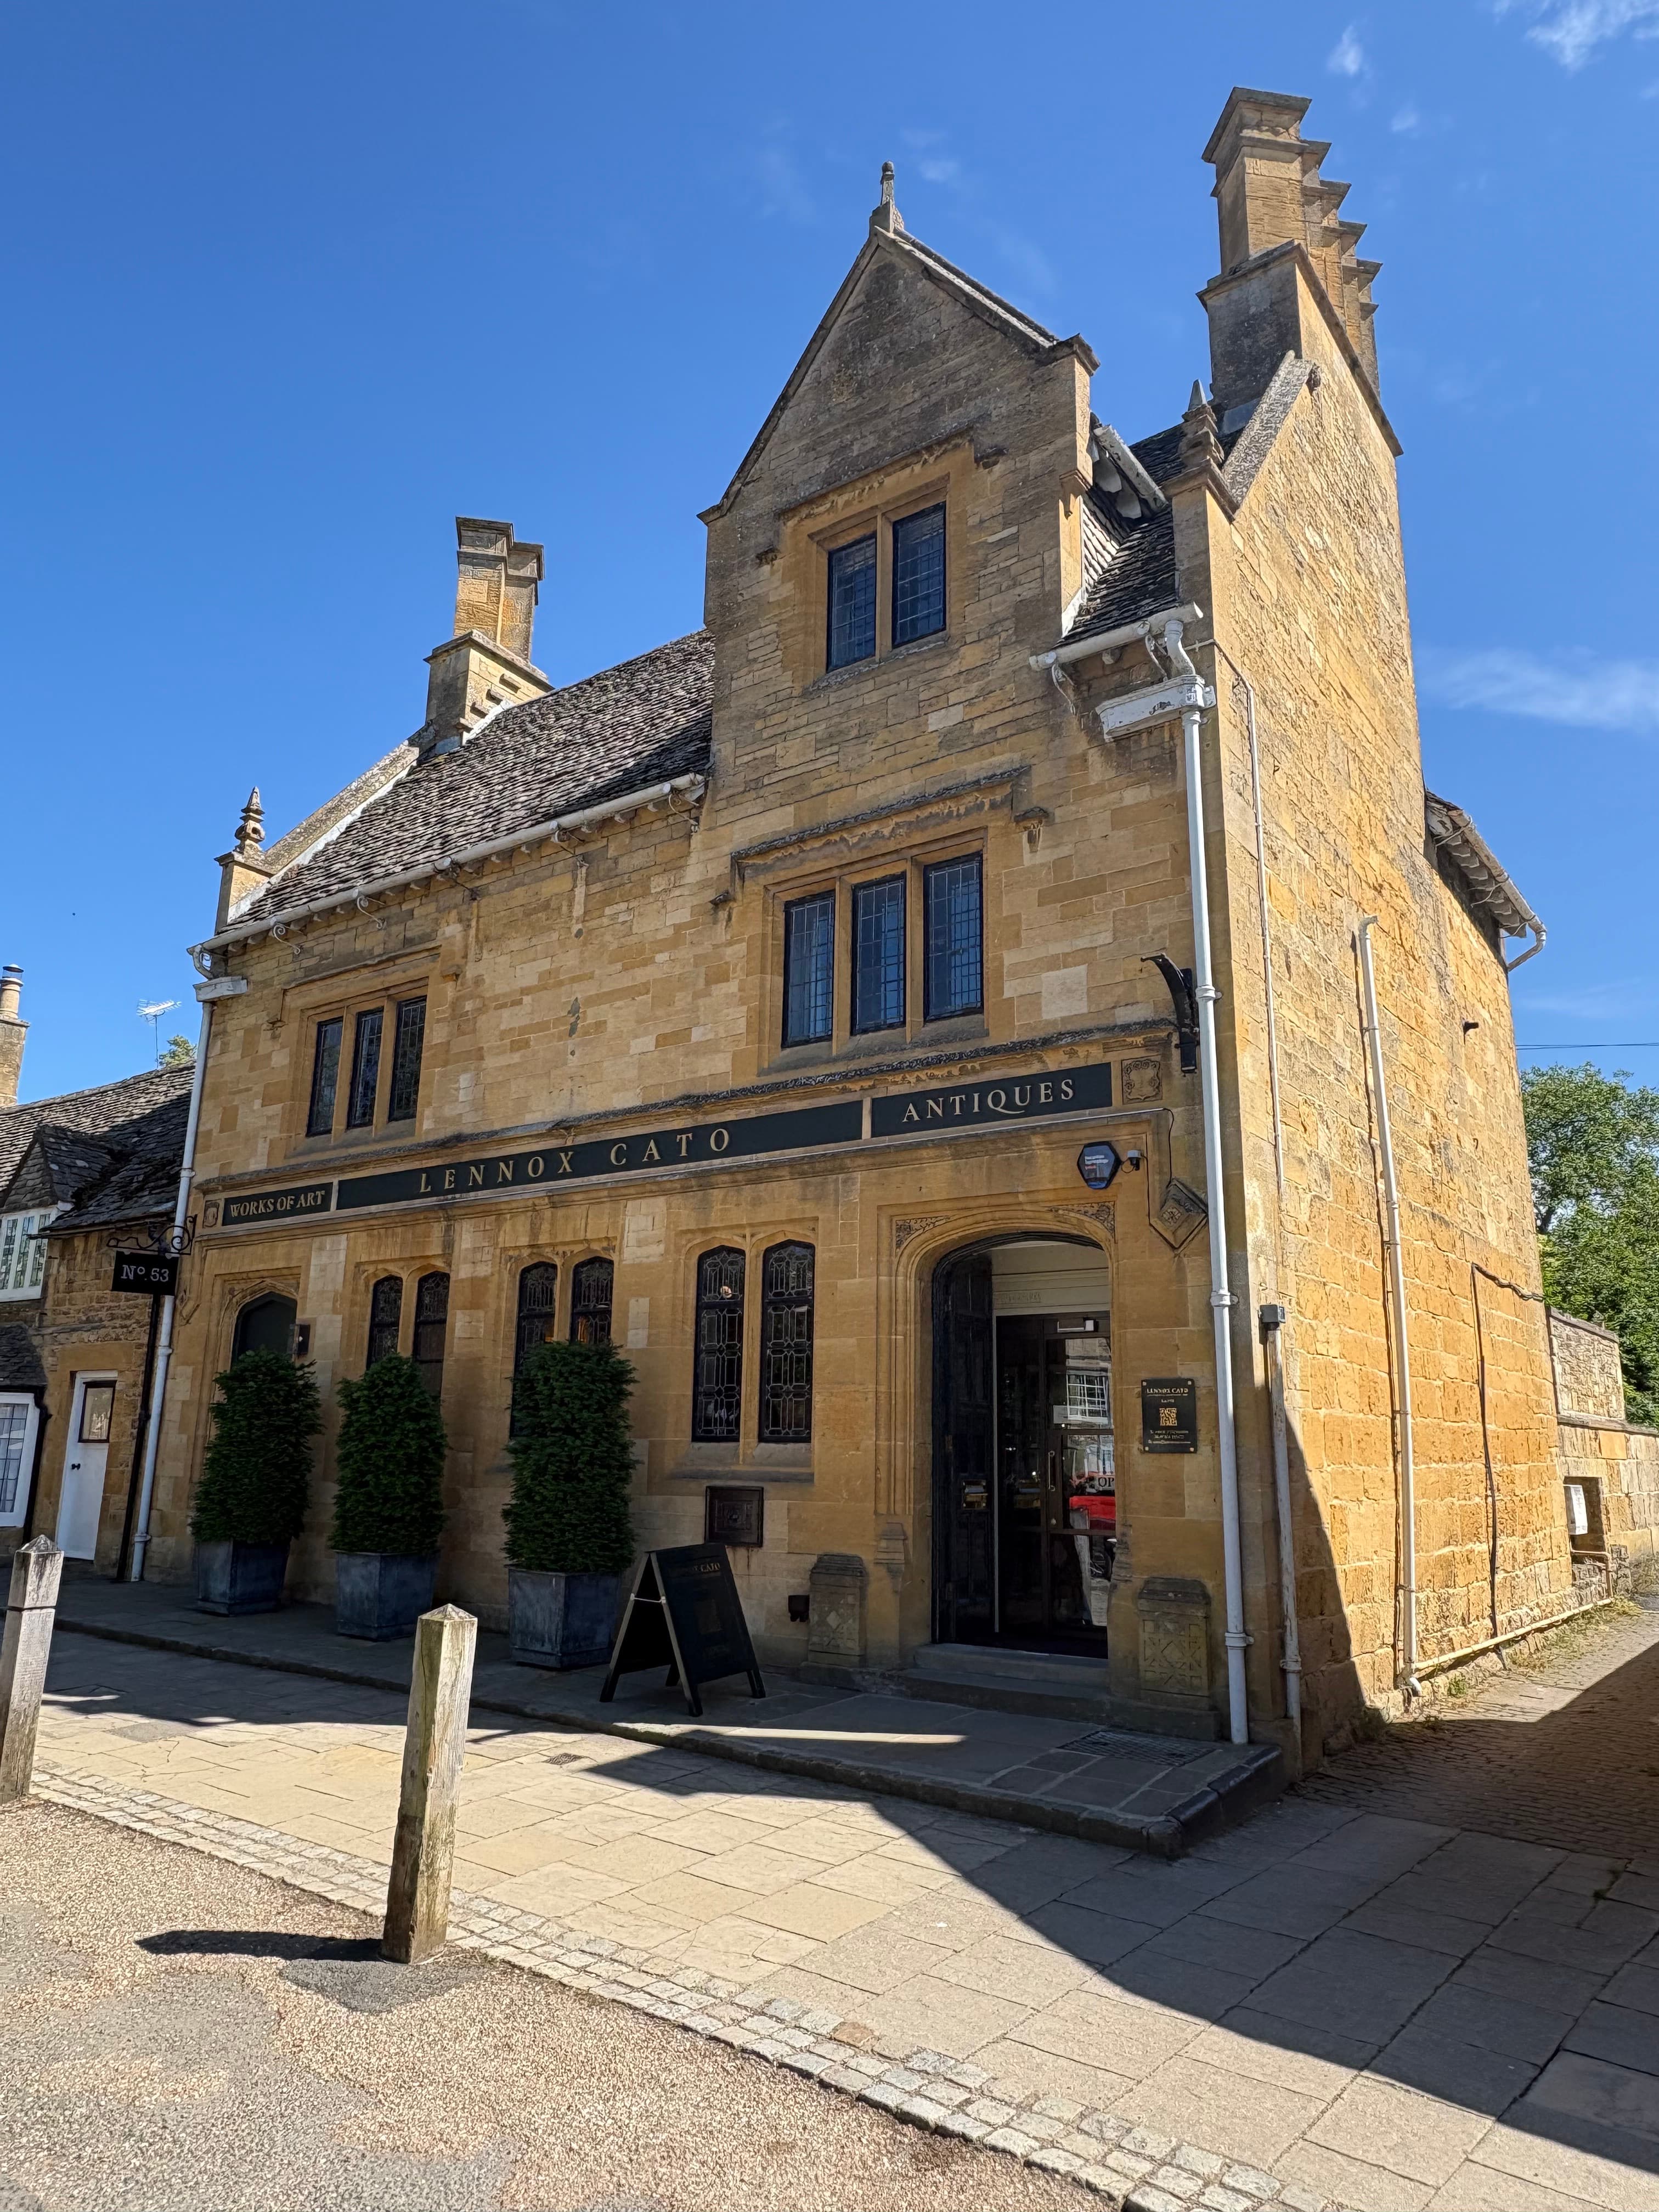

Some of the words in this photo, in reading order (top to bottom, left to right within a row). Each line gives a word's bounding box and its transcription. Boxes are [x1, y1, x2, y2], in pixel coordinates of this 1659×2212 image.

[901, 1079, 1075, 1122] ANTIQUES
[419, 1151, 574, 1193] LENNOX
[610, 1128, 730, 1165] CATO
[230, 1198, 275, 1218] WORKS
[276, 1195, 296, 1211] OF
[296, 1190, 325, 1208] ART
